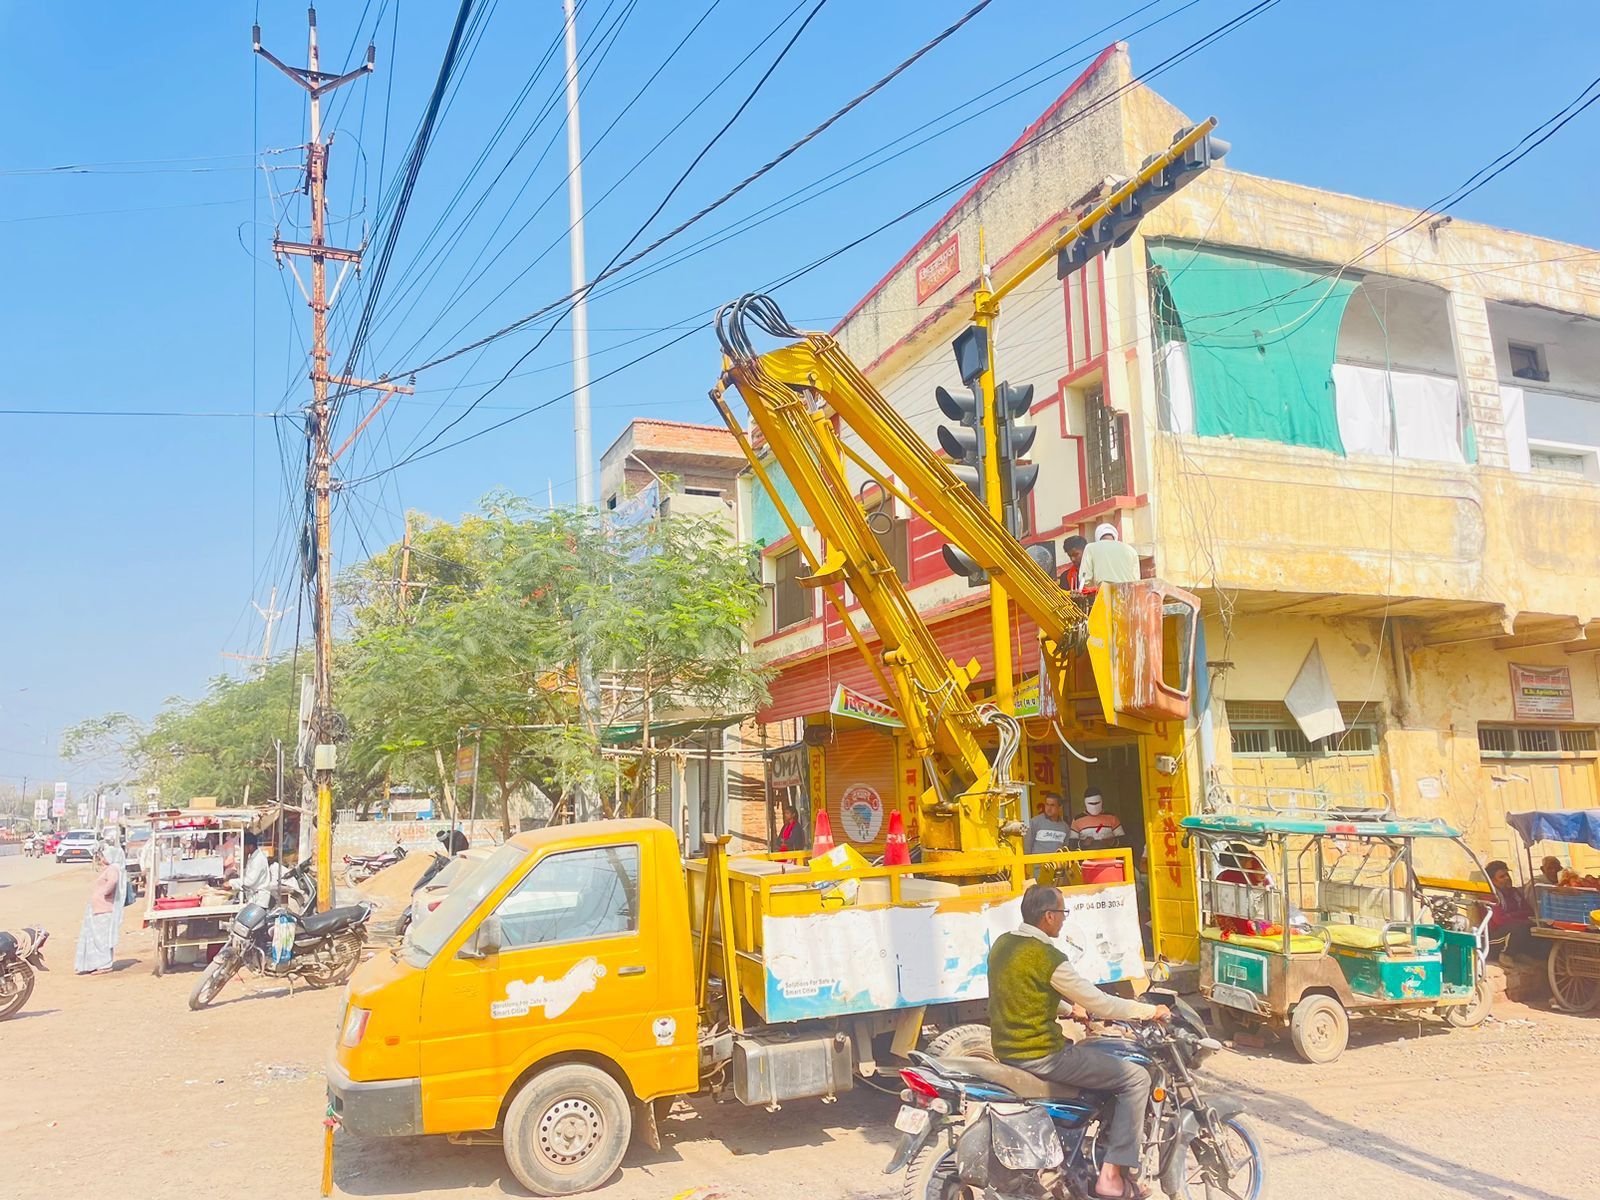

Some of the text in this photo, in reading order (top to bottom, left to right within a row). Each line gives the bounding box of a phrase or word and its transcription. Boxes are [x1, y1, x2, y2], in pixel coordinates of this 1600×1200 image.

[1073, 903, 1084, 911] MP
[1096, 901, 1106, 909] DB
[785, 980, 809, 988] Solutions
[785, 988, 801, 996] Smart
[492, 1001, 518, 1010] Solutions
[492, 1007, 527, 1017] Smart Cities
